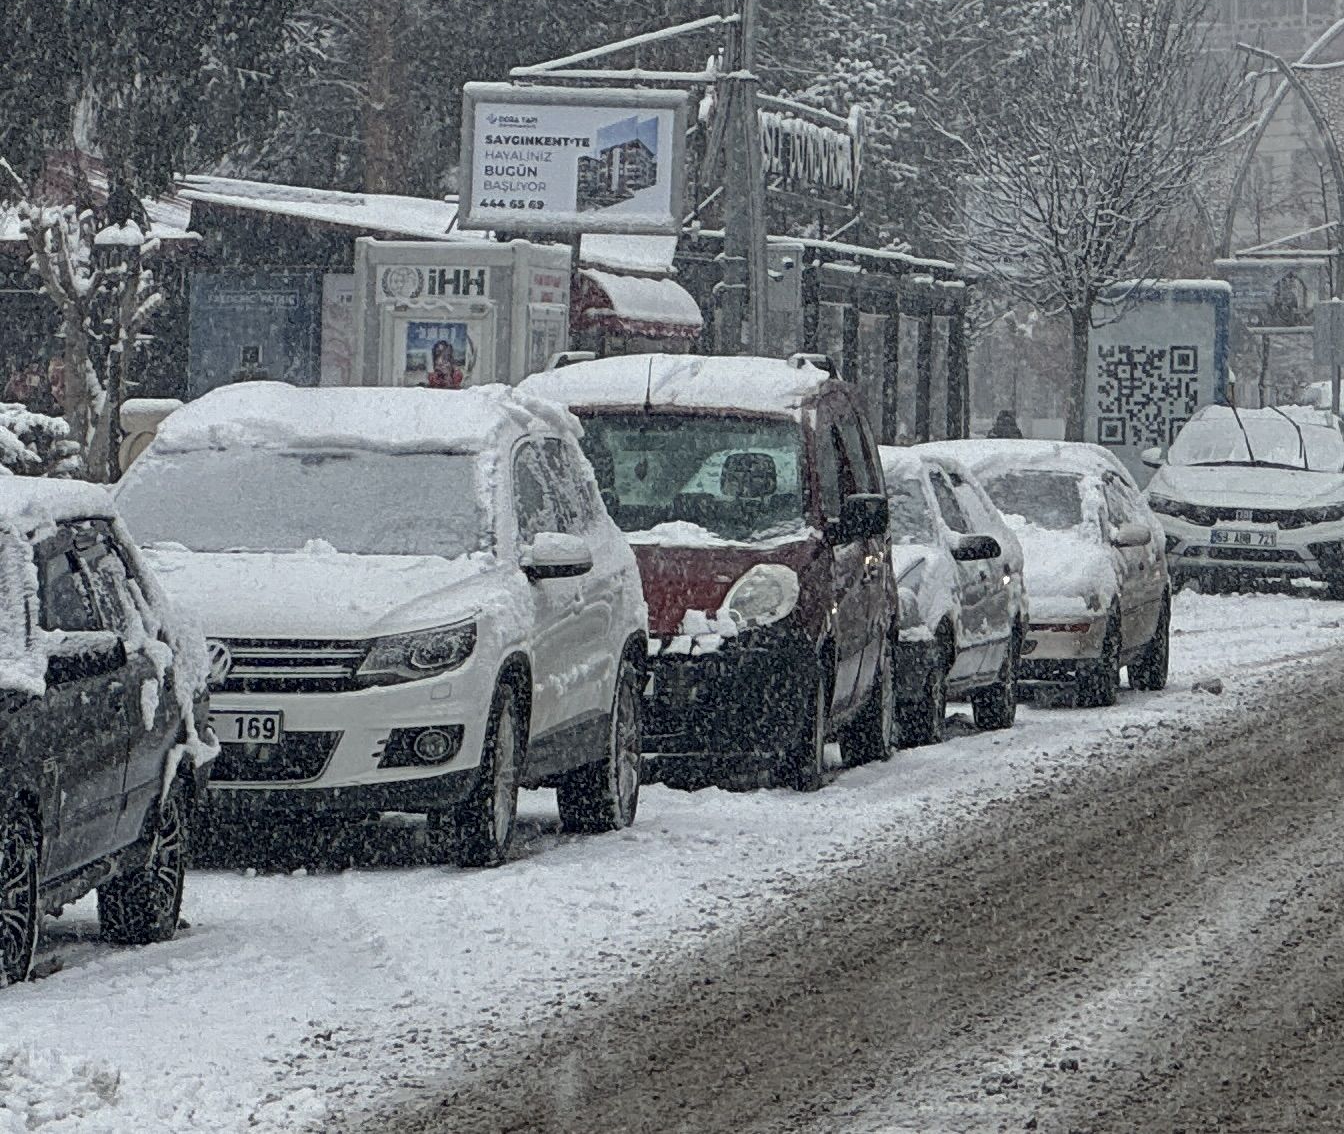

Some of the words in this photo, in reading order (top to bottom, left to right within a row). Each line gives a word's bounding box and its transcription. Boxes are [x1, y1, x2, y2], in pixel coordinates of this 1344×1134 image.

[484, 164, 538, 177] BUGÜN
[480, 198, 506, 208] 444
[235, 716, 276, 740] 169
